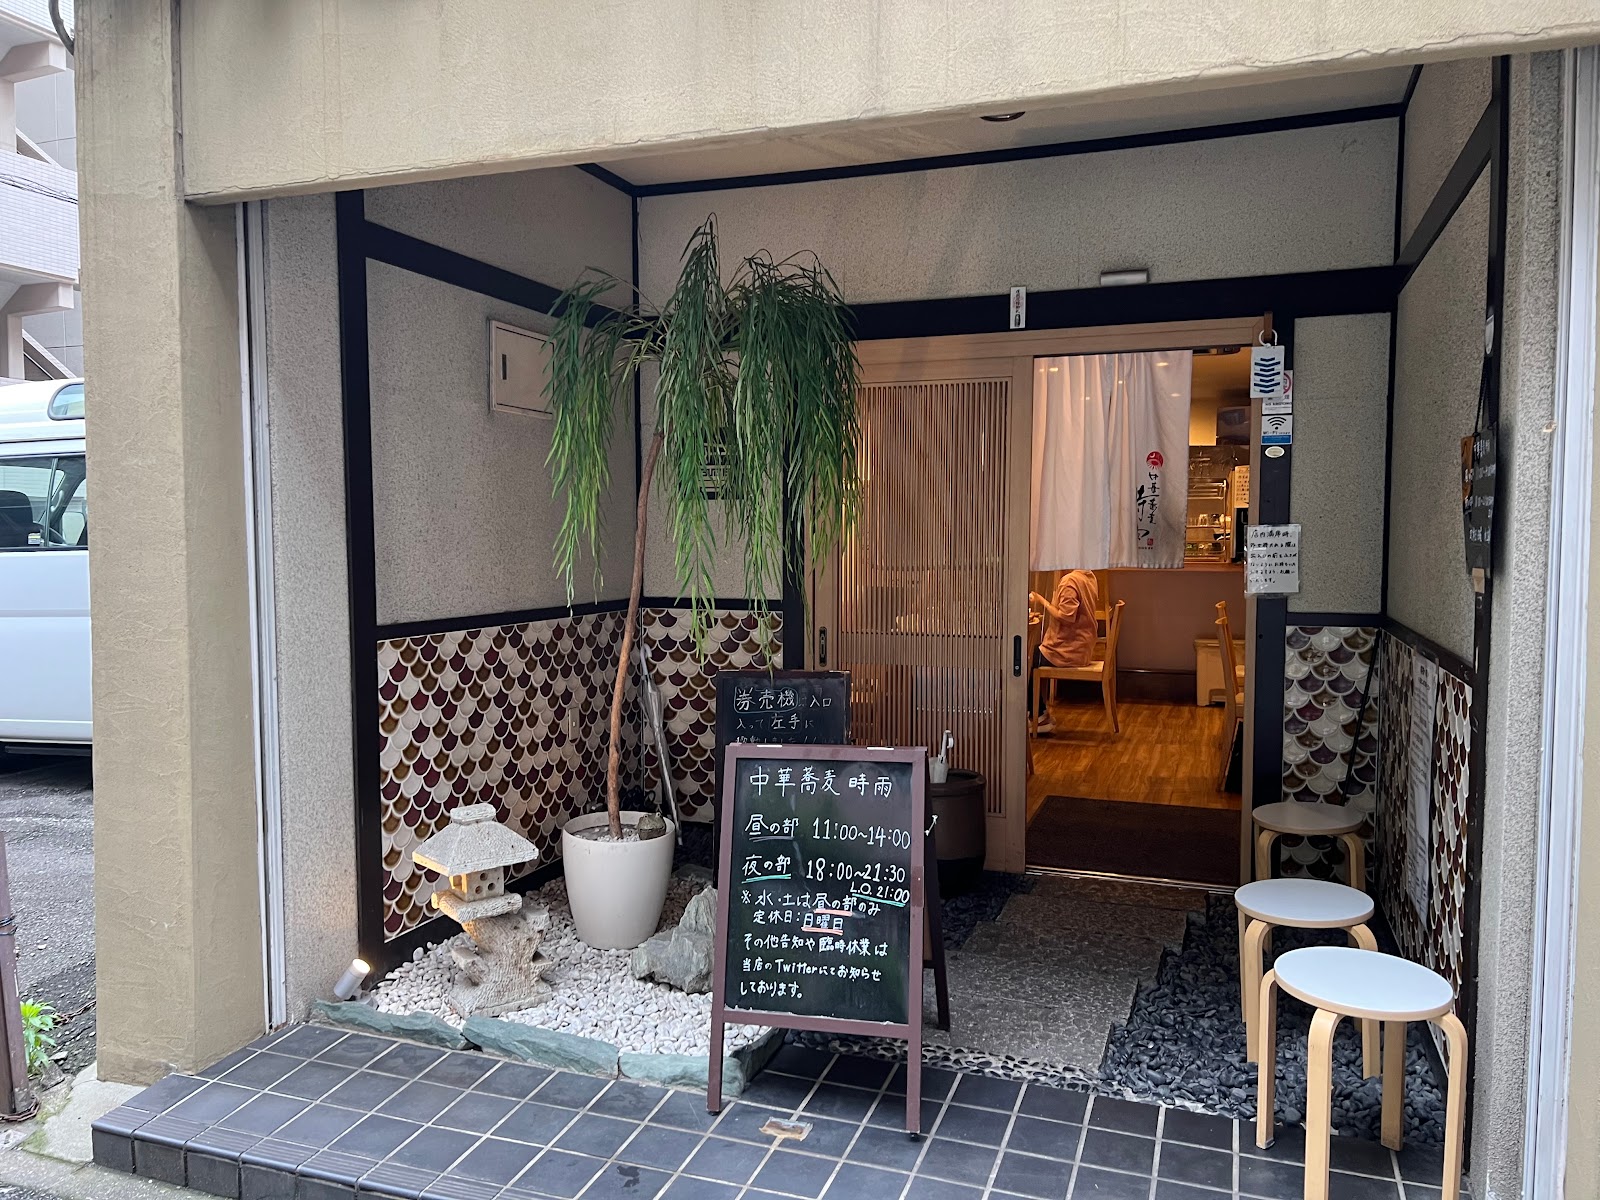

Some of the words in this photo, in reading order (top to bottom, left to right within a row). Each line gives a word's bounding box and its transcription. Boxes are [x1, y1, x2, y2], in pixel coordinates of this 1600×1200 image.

[736, 687, 795, 711] 券売機
[809, 694, 832, 708] 入口
[749, 766, 841, 797] 中華蕎麦
[848, 773, 893, 798] 時雨
[745, 814, 800, 837] 昼の部
[741, 854, 791, 877] 夜の部
[876, 885, 910, 903] 21:00
[740, 981, 803, 999] しております。
